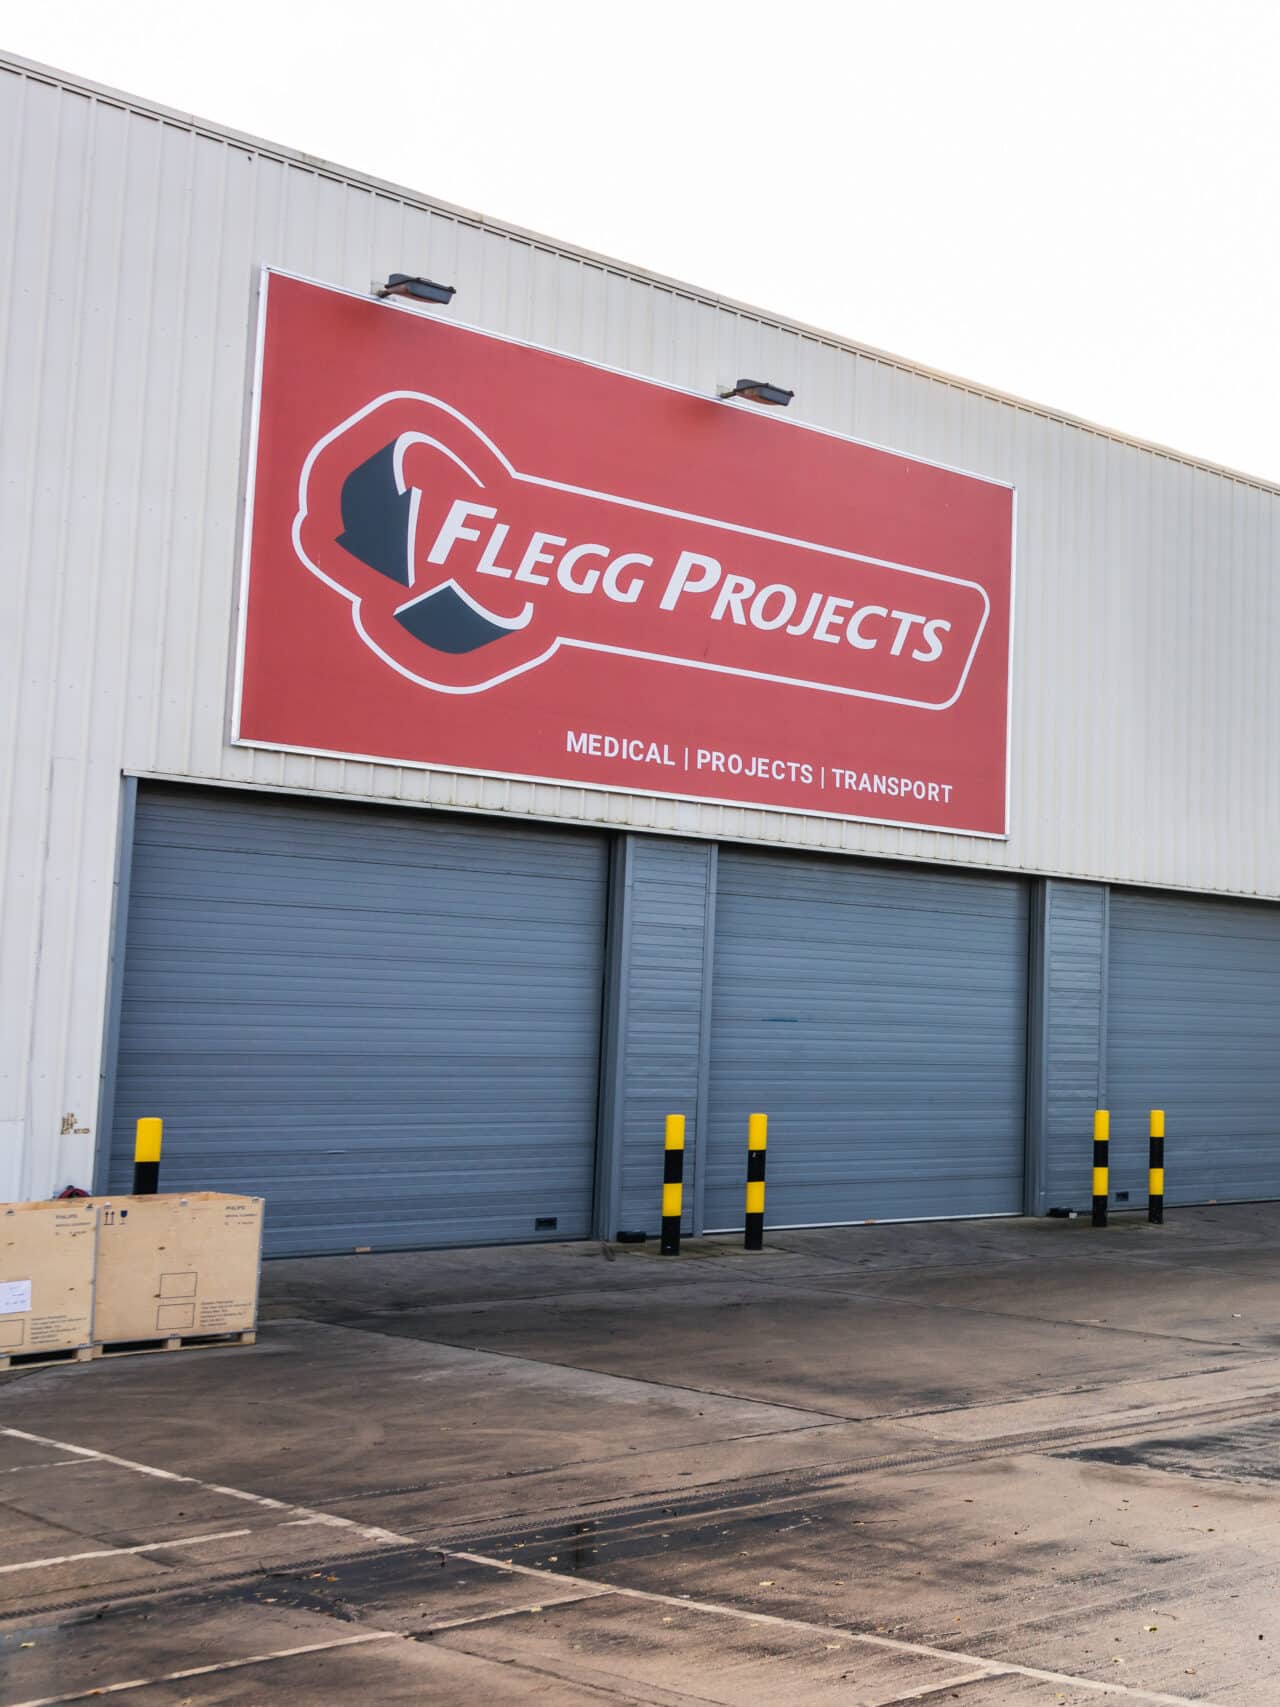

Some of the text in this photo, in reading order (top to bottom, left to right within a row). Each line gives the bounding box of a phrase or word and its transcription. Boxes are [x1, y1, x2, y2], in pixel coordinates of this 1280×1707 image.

[426, 499, 952, 663] FLEGG PROJECTS
[566, 730, 953, 804] MEDICAL PROJECTS TRANSPORT
